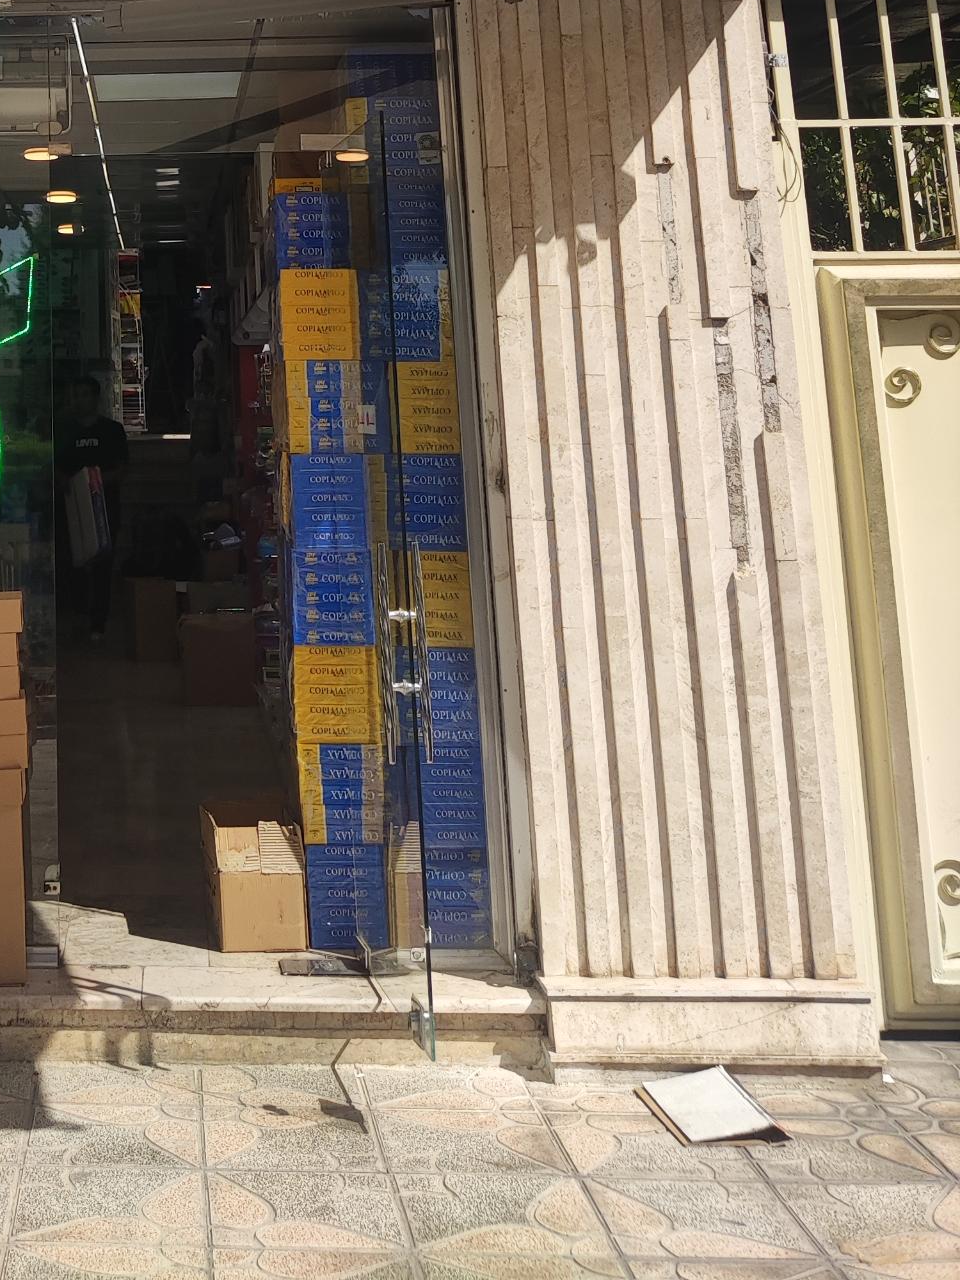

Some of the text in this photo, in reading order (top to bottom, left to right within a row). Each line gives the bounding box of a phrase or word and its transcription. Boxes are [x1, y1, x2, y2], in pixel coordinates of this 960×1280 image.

[410, 457, 457, 468] COPIMAX
[413, 476, 459, 487] COPIMAX
[414, 495, 460, 506] COPIMAX
[414, 514, 460, 525] COPIMAX
[414, 534, 462, 545] COPIMAX
[423, 573, 459, 583] OPIMAX
[424, 592, 460, 601] OPIMAX
[424, 611, 460, 620] OPIMAX
[427, 631, 463, 641] OPIMAX
[428, 651, 469, 663] OPIMAX
[429, 671, 470, 683] OPIMAX
[431, 690, 471, 702] OPIMAX
[432, 710, 473, 721] OPIMAX
[431, 768, 472, 778] COPIMAX
[433, 789, 474, 798] COPIMAX
[435, 810, 477, 819] COPIMAX
[437, 831, 479, 840] COPIMAX
[425, 851, 464, 861] COPIMA
[426, 871, 465, 881] COPIMA
